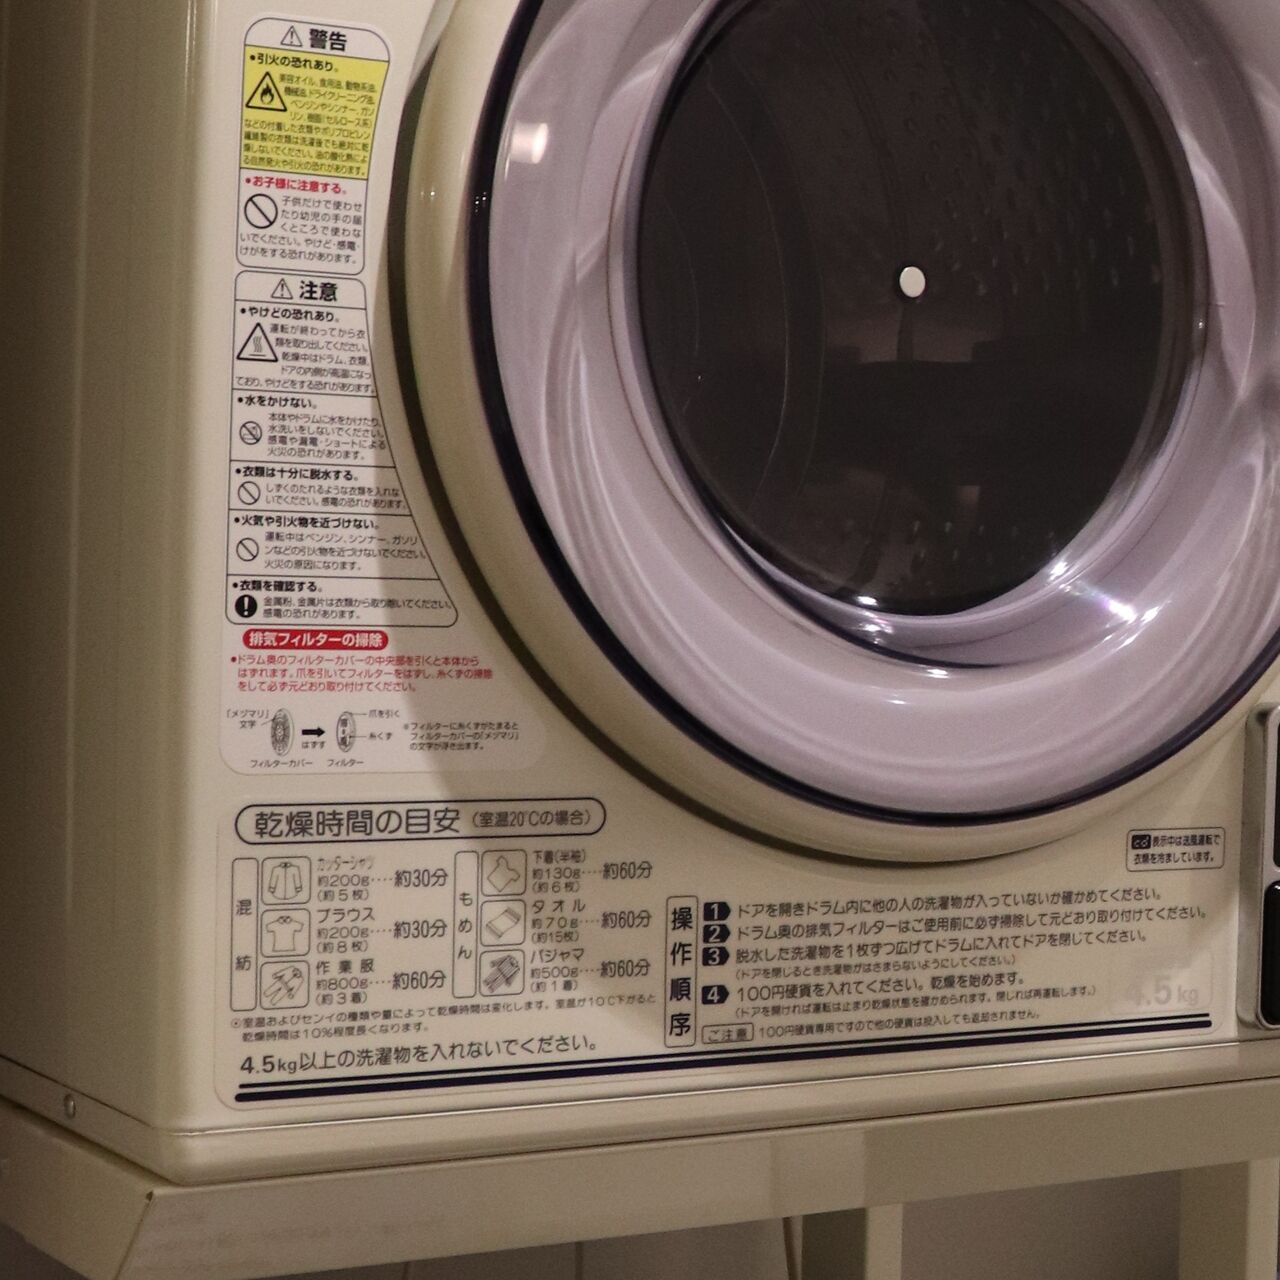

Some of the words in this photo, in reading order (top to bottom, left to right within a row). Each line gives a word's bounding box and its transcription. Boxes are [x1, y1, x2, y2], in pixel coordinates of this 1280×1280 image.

[309, 28, 347, 51] 警告
[258, 53, 339, 72] 引火の恐れあり。
[252, 176, 347, 195] お子様に注意する。
[282, 195, 362, 212] 子供だけで使わせ
[281, 223, 362, 238] くところで使わな
[299, 280, 338, 302] 注意
[248, 307, 340, 323] やけどの恐れあり。
[245, 396, 317, 409] 水をかけない。
[242, 466, 359, 481] 衣類は十分に脱水する。
[241, 515, 379, 530] 火気や引火物を近づけない。
[264, 558, 361, 571] 火災の原因になります。
[239, 580, 322, 593] 衣類を確認する。
[249, 631, 383, 648] 排気フィルターの掃除
[251, 759, 313, 768] フィルターカバー
[327, 758, 364, 767] フィルター
[255, 807, 460, 838] 乾燥時間の目安
[394, 868, 448, 888] 約30分
[533, 867, 581, 880] 約130g
[603, 861, 653, 880] 約60分
[318, 874, 370, 888] 約200g
[317, 907, 375, 923] ブラウス
[601, 910, 651, 929] 約60分
[317, 925, 370, 939] 約200g
[393, 919, 448, 939] 約30分
[531, 947, 585, 963] パジャマ
[530, 966, 579, 979] 約500g
[600, 958, 650, 978] 約60分
[316, 977, 368, 990] 約800g
[392, 970, 446, 990] 約60分
[707, 1028, 748, 1043] ご注意
